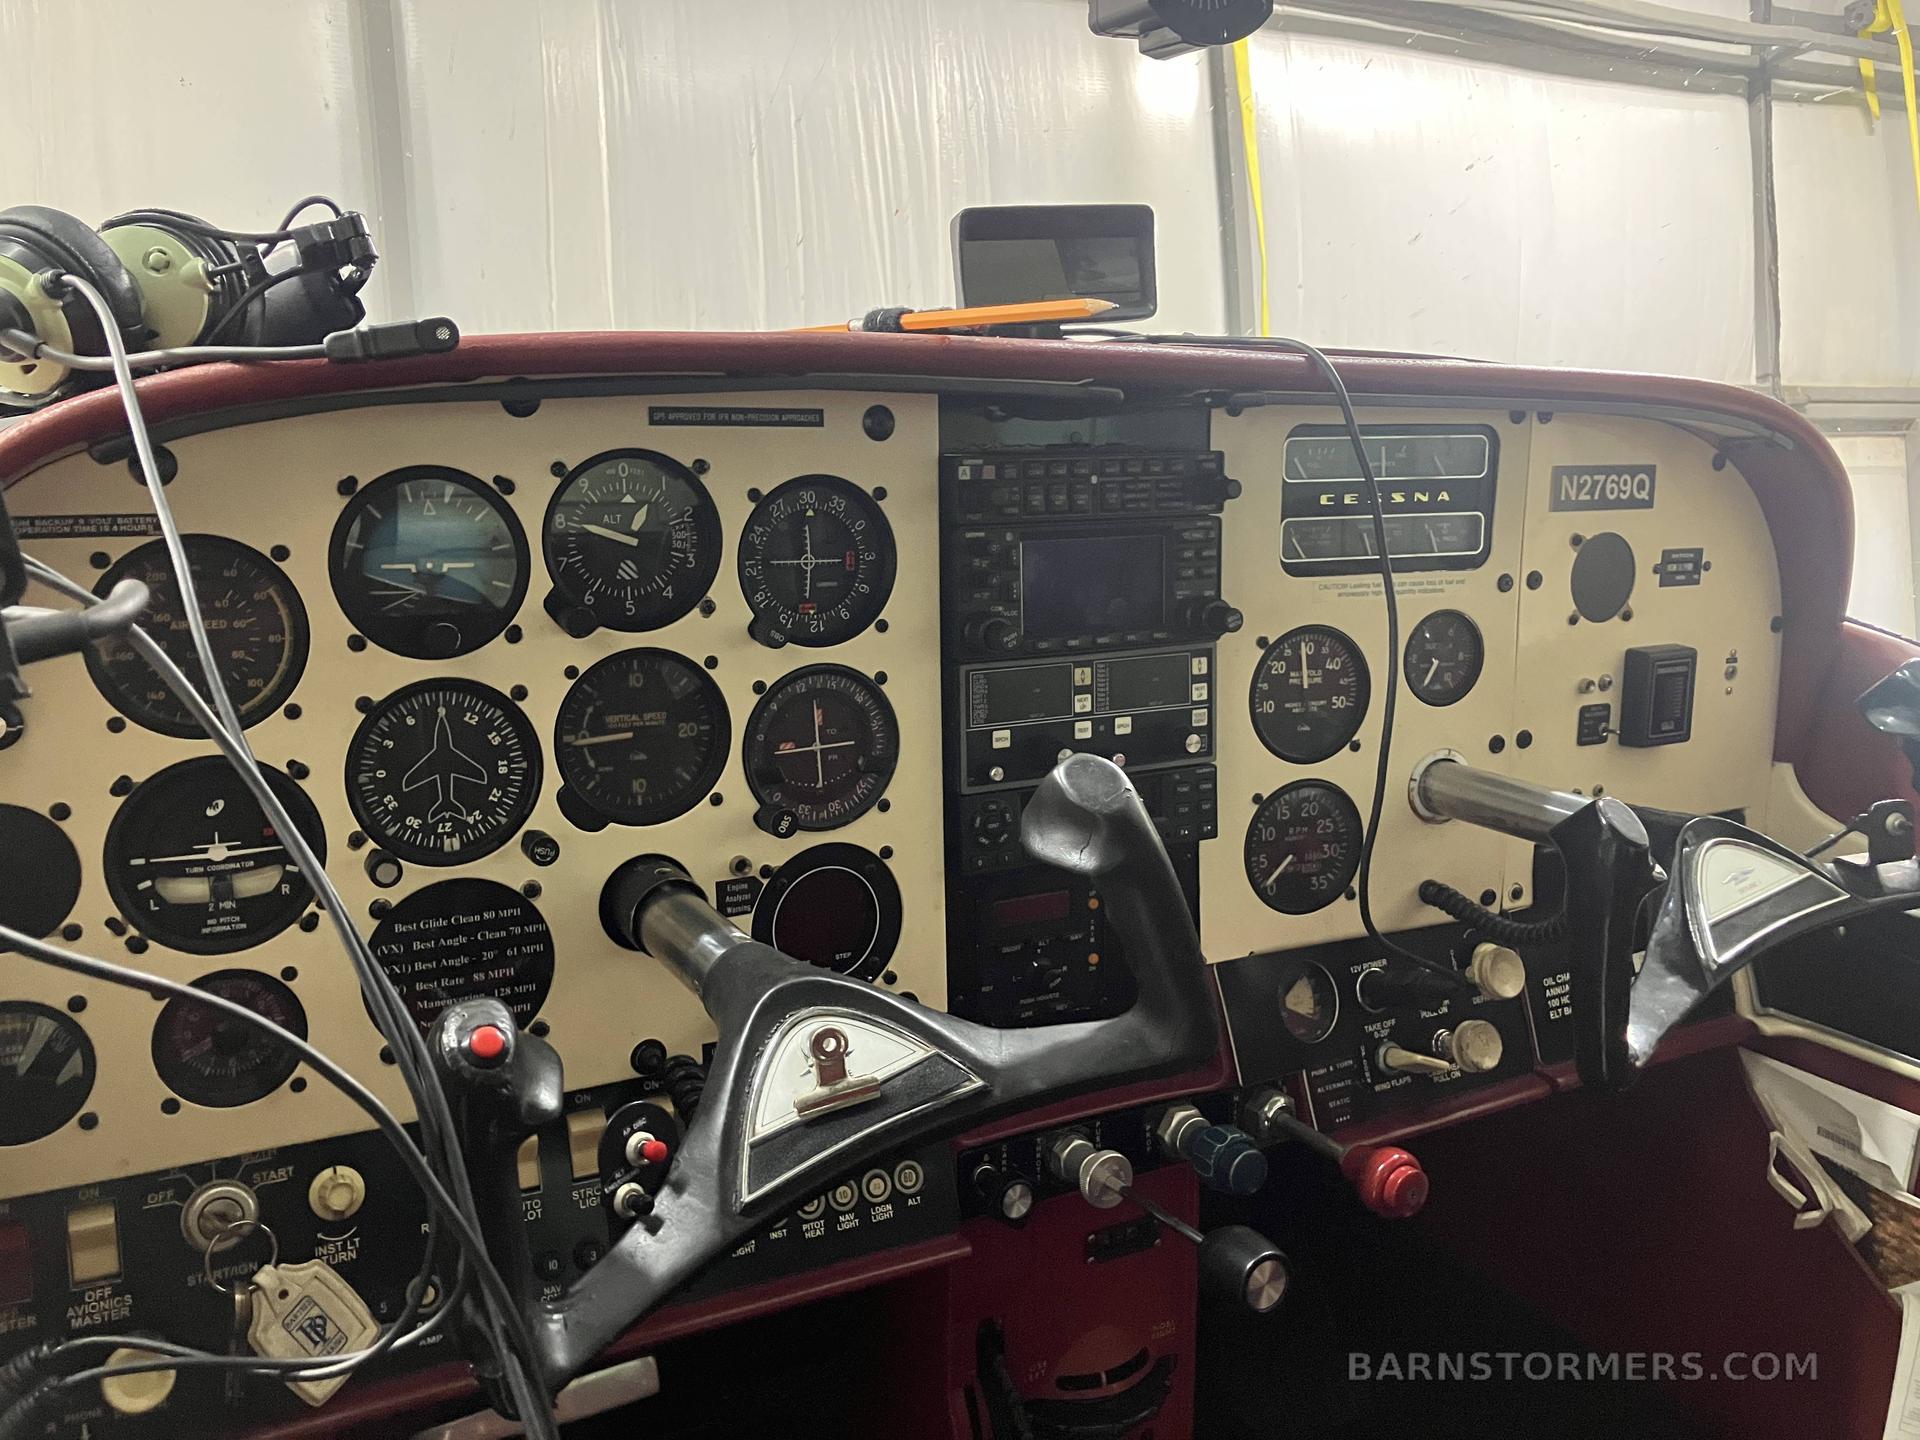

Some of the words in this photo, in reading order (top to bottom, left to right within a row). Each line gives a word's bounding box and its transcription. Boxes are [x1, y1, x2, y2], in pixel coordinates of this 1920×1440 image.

[618, 462, 629, 478] 0
[578, 478, 590, 494] 9
[1560, 473, 1650, 501] N2769Q
[799, 490, 816, 504] 30
[829, 495, 847, 512] 33
[683, 505, 694, 521] 2
[769, 499, 785, 518] 27
[554, 513, 567, 529] 8
[602, 513, 623, 525] ALT
[749, 524, 765, 544] 24
[558, 557, 569, 573] 7
[685, 553, 696, 568] 3
[584, 589, 595, 606] 6
[661, 585, 674, 600] 4
[625, 601, 636, 616] 5
[169, 619, 228, 631] AIREED
[810, 620, 825, 633] 12
[1271, 661, 1286, 675] 20
[1325, 657, 1341, 671] 40
[628, 671, 644, 688] 10
[1263, 700, 1275, 713] 10
[1331, 695, 1346, 709] 50
[463, 712, 480, 726] 12
[677, 721, 698, 738] 20
[486, 731, 502, 746] 15
[375, 769, 387, 779] 0
[498, 759, 509, 775] 18
[632, 777, 648, 794] 10
[488, 787, 503, 802] 21
[382, 794, 399, 811] 33
[1301, 801, 1320, 817] 20
[1276, 805, 1291, 820] 15
[405, 815, 423, 830] 30
[437, 822, 454, 834] 27
[778, 814, 792, 834] OBS
[1316, 818, 1334, 834] 25
[1261, 826, 1276, 842] 10
[1322, 843, 1340, 858] 30
[185, 866, 205, 874] TURN
[206, 860, 255, 872] COORDINATOR
[281, 884, 290, 895] R
[727, 883, 749, 893] Engine
[1309, 876, 1328, 891] 35
[150, 899, 160, 911] L
[219, 899, 237, 910] MIN
[725, 893, 752, 904] Analyzer
[726, 904, 752, 915] Warning
[394, 923, 417, 934] Best
[419, 917, 449, 930] Glide
[451, 913, 481, 926] Clean
[482, 909, 496, 920] 80
[497, 907, 521, 919] MPH
[412, 938, 436, 952] Best
[437, 932, 469, 948] Angle
[476, 929, 507, 941] Clean
[509, 926, 522, 937] 70
[523, 922, 547, 935] MPH
[414, 959, 438, 972] Best
[439, 953, 470, 969] Angle
[506, 946, 518, 957] 61
[520, 942, 544, 955] MPH
[835, 952, 852, 961] STEP
[415, 978, 438, 992] Best
[440, 976, 466, 988] Rate
[472, 971, 486, 983] 88
[487, 966, 516, 981] MPH
[1543, 977, 1556, 987] OIL
[494, 987, 512, 998] 128
[513, 982, 537, 995] MPH
[1546, 984, 1570, 998] ANNUA
[1548, 997, 1560, 1008] 100
[1550, 1008, 1562, 1020] ELT
[643, 1080, 660, 1091] ON
[574, 1094, 592, 1105] ON
[252, 1165, 295, 1184] START
[147, 1189, 176, 1204] OFF
[907, 1195, 922, 1207] ALT
[839, 1212, 856, 1223] NAV
[870, 1210, 894, 1223] LIGHT
[802, 1219, 825, 1232] PITOT
[836, 1218, 860, 1232] LIGHT
[769, 1228, 788, 1240] INST
[804, 1227, 825, 1240] HEAT
[315, 1241, 343, 1257] INST
[346, 1237, 360, 1250] LT
[590, 1250, 597, 1261] 3
[548, 1259, 558, 1271] 10
[84, 1287, 113, 1303] OFF
[543, 1284, 562, 1296] NAV
[66, 1294, 133, 1319] AVIONICS
[70, 1306, 131, 1330] MASTER
